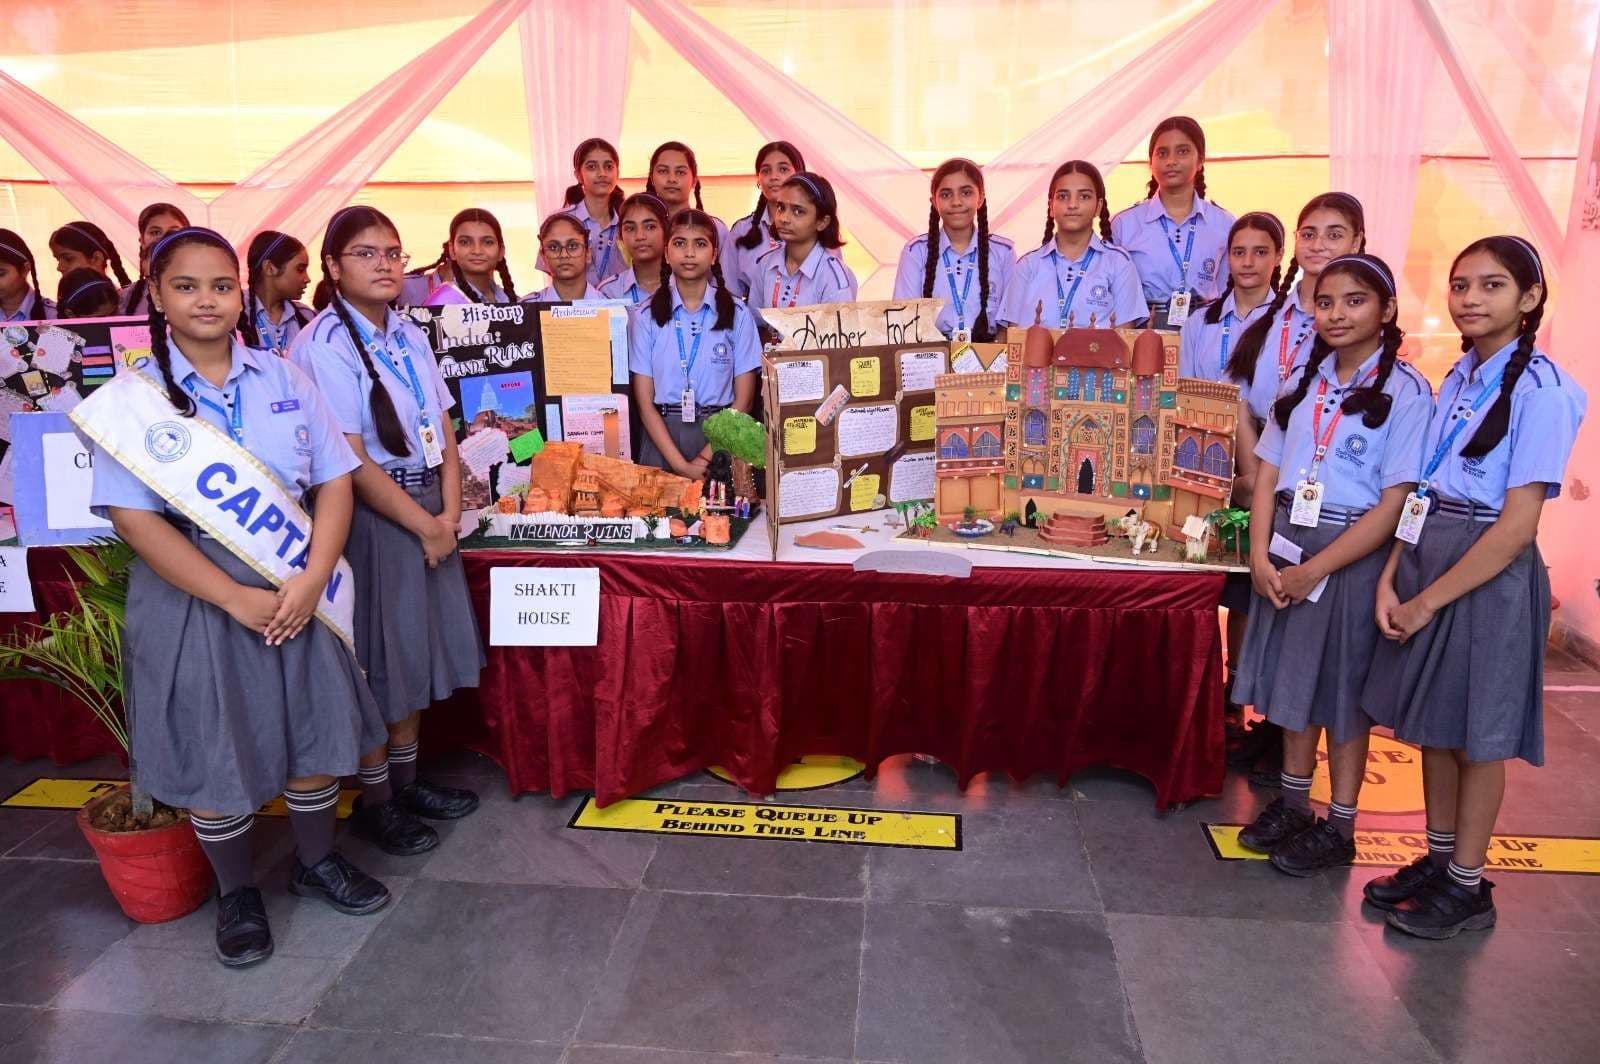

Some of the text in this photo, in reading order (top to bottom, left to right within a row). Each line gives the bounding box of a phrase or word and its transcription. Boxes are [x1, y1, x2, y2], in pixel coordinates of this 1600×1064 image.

[461, 307, 523, 323] History
[792, 304, 922, 350] Amber Fort
[441, 357, 489, 378] ALANDA
[196, 462, 343, 604] CAPTAN
[512, 524, 633, 540] NALANDA RUINS
[514, 583, 576, 597] SHAKTI
[518, 611, 571, 625] HOUSE
[655, 803, 746, 818] PLEASE
[755, 808, 838, 823] QUEUE
[661, 819, 867, 840] BEHIND THIS LINE
